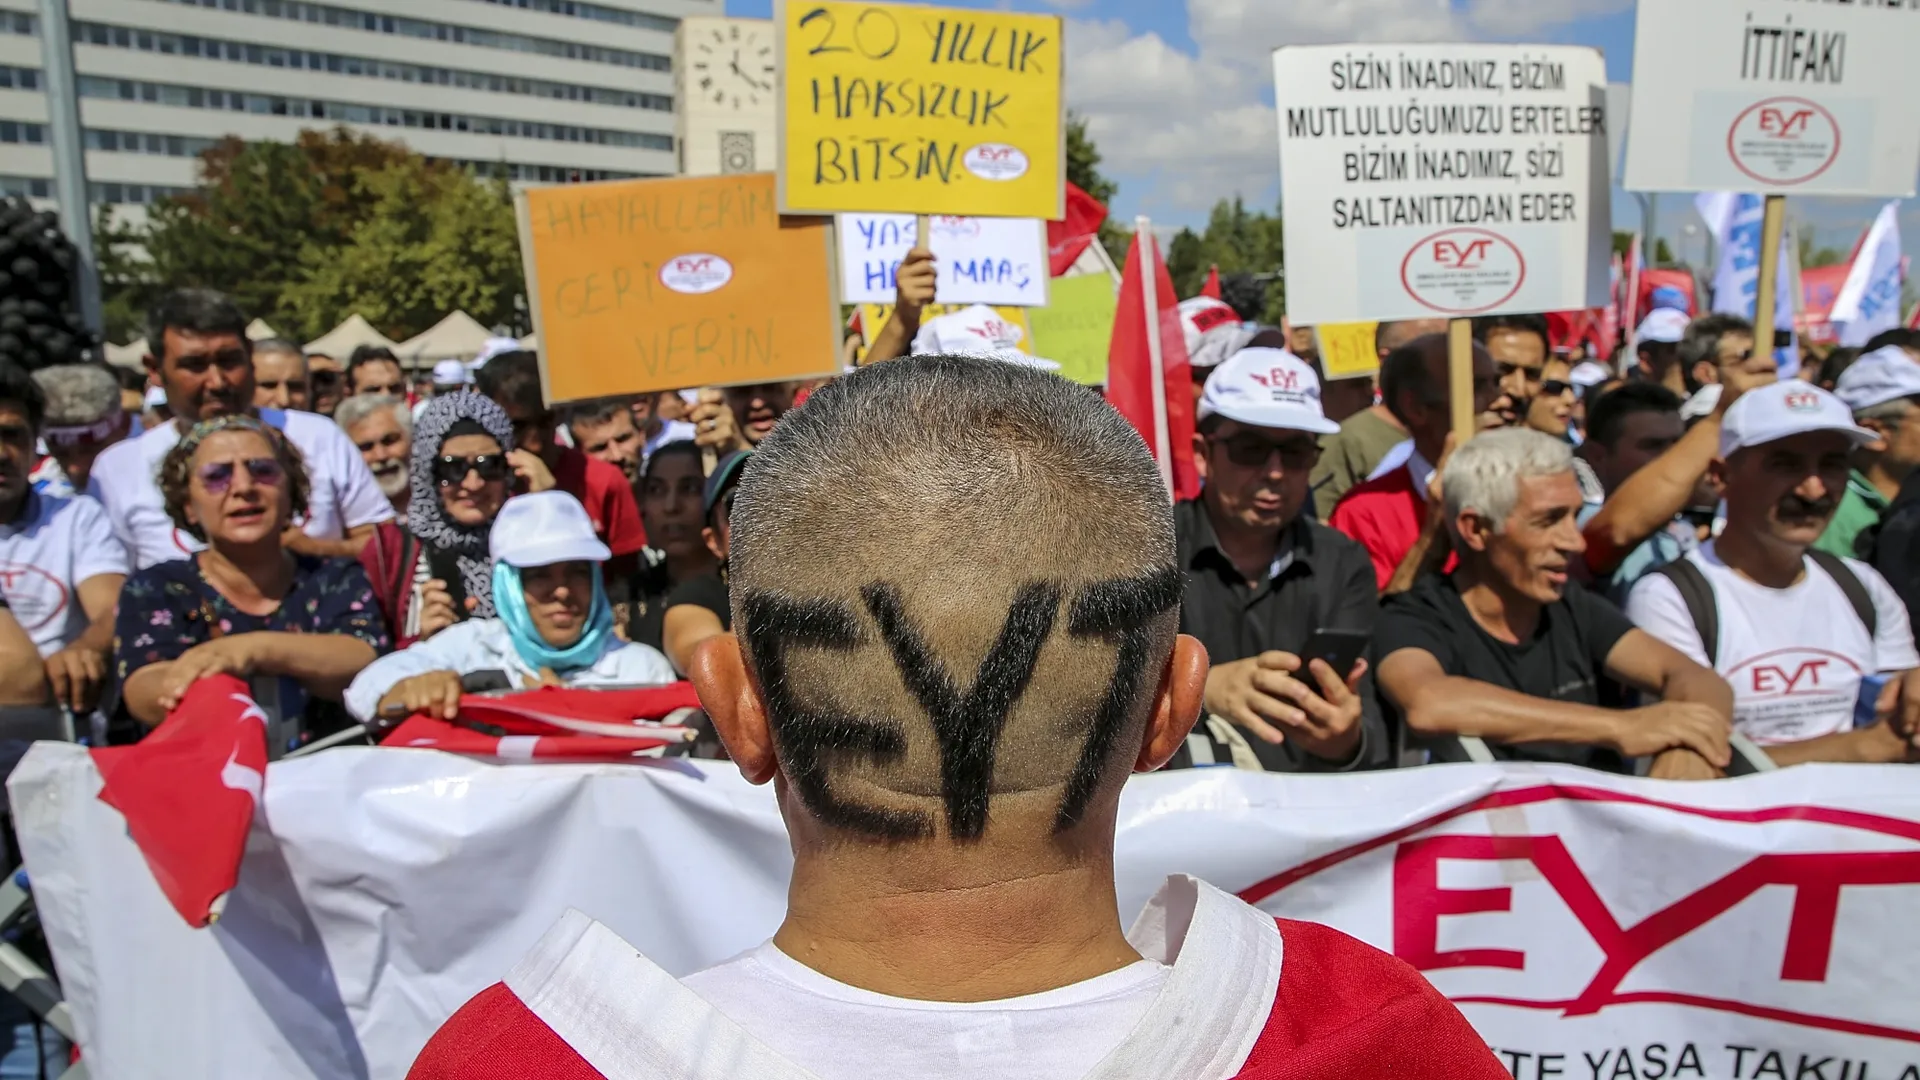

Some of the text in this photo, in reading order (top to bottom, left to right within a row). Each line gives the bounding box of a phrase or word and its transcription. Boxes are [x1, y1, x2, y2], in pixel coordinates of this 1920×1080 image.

[799, 8, 1048, 74] 20 YILLIK
[1740, 12, 1847, 84] İTTİFAKI
[1330, 53, 1566, 95] SİZİN İNADINIZ, BİZİM
[811, 75, 1010, 128] HAKSIZLIK
[1287, 98, 1605, 139] MUTLULUĞUMUZU ERTELER
[1758, 107, 1815, 137] EYT
[1343, 142, 1565, 184] BİZİM İNADIMIZ, SİZİ
[1332, 193, 1577, 228] SALTANITIZDAN EDER
[674, 257, 714, 274] EYT
[1432, 239, 1493, 268] EYT
[555, 261, 656, 319] GERİ
[1752, 660, 1829, 695] EYT
[743, 566, 1186, 842] EYT
[1393, 833, 1920, 1019] EYT
